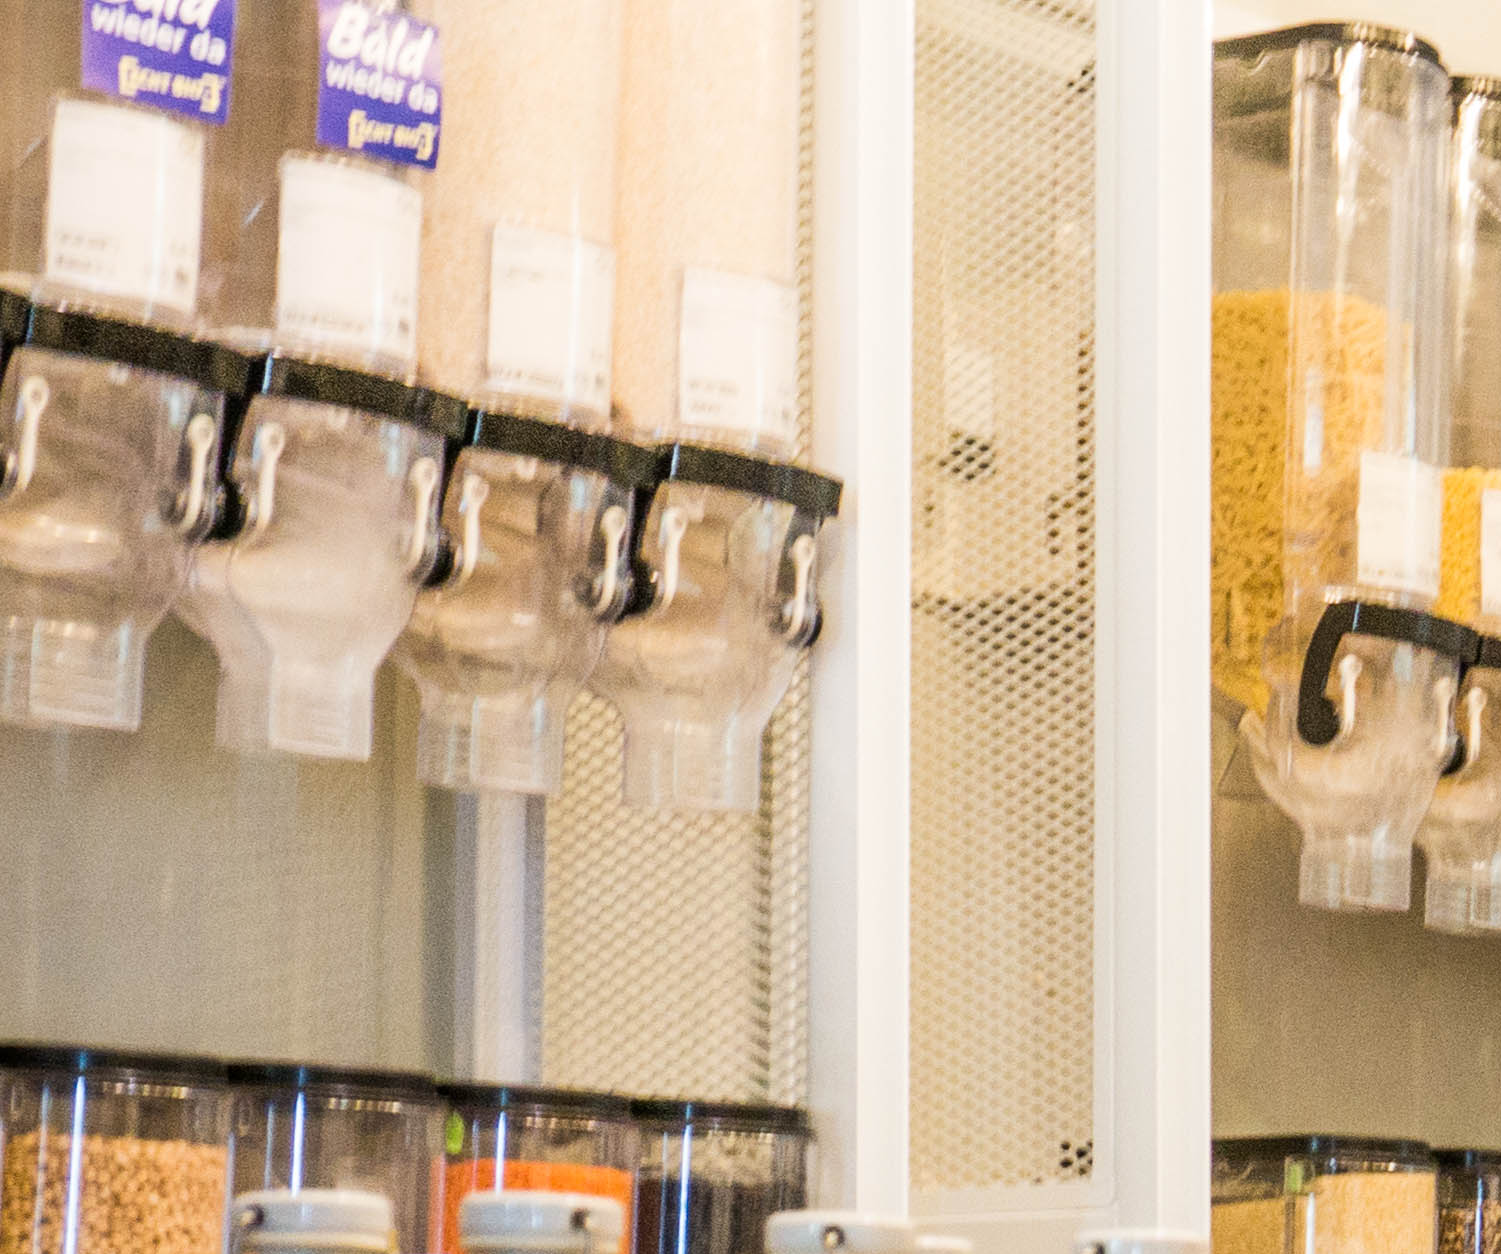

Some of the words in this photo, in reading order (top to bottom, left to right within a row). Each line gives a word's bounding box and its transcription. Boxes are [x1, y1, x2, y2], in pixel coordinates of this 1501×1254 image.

[91, 4, 186, 54] wieder
[190, 29, 226, 66] da
[327, 3, 434, 79] Bald
[326, 60, 405, 104] wieder
[408, 80, 438, 114] da
